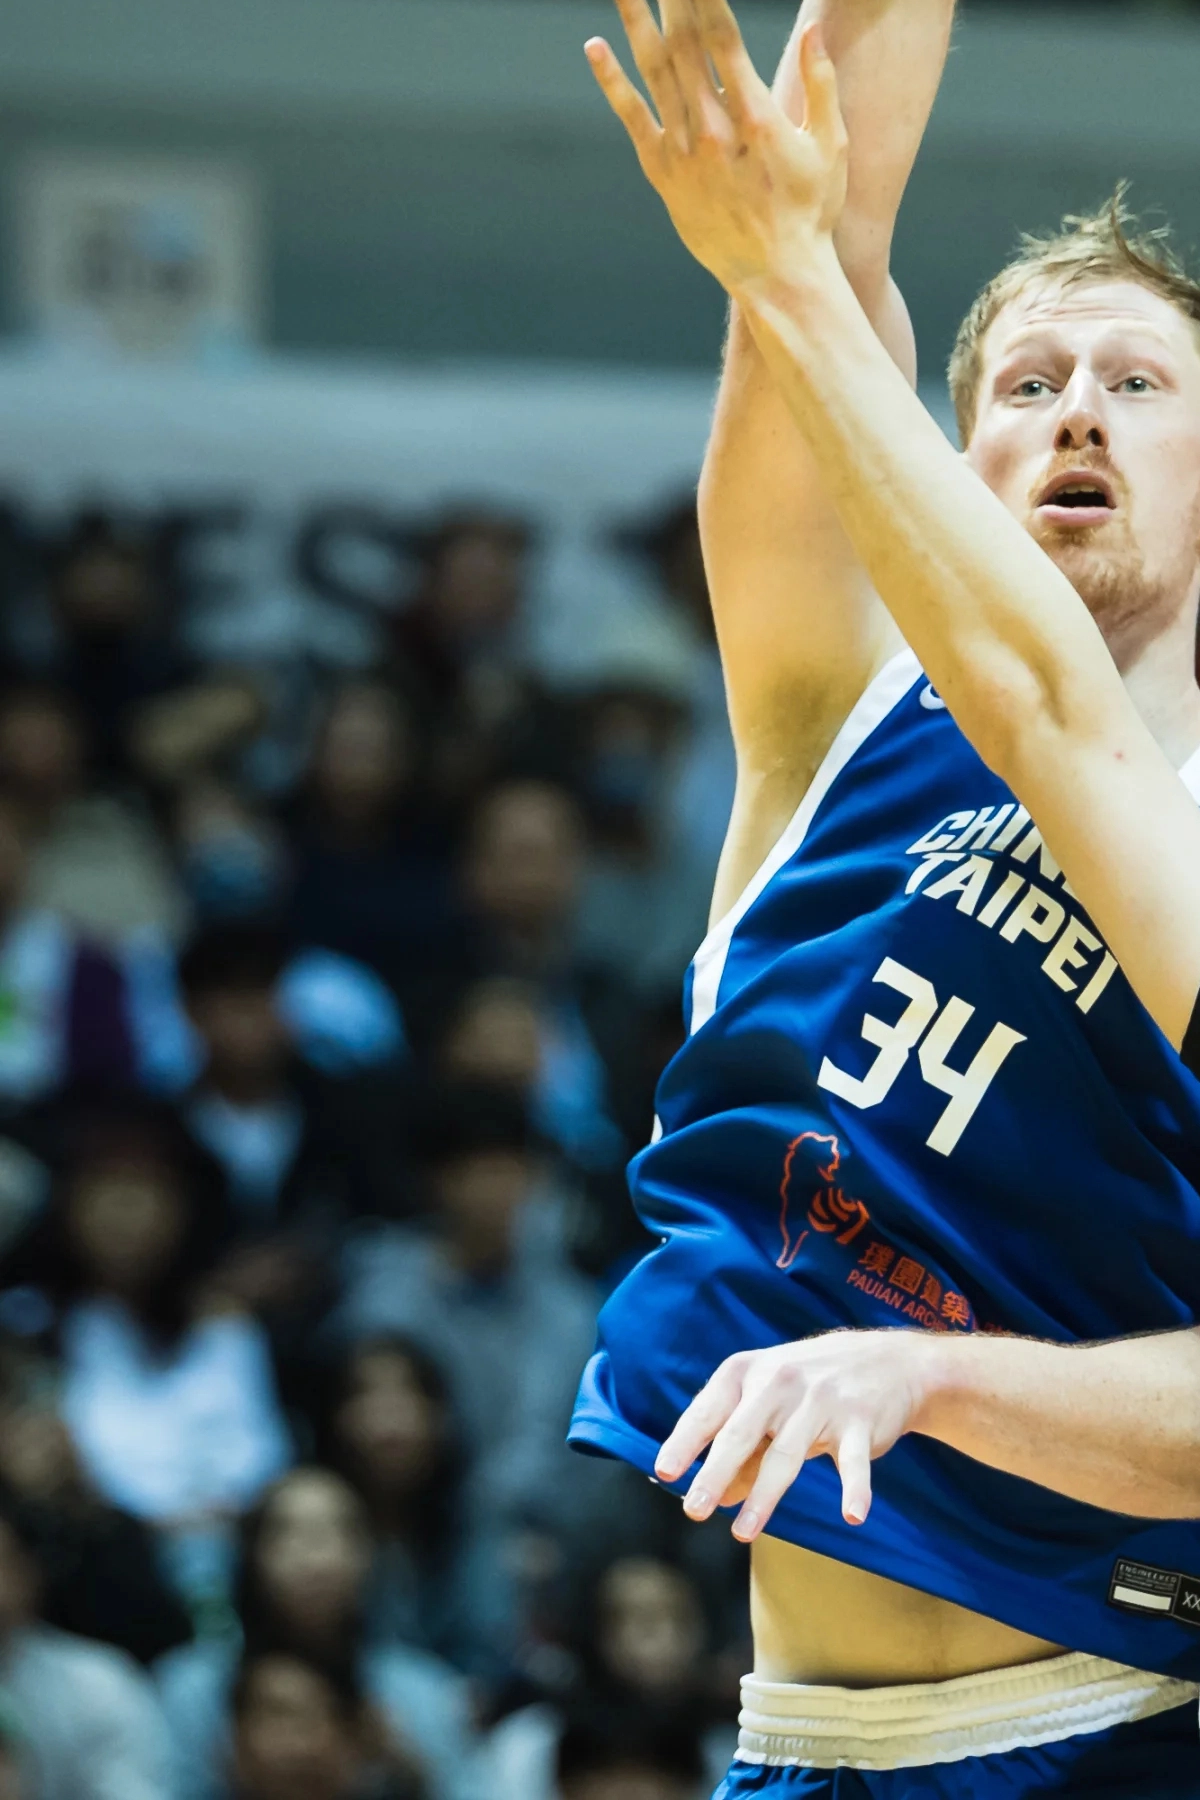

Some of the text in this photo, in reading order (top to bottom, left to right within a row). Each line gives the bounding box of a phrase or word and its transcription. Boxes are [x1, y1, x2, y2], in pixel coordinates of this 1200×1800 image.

[905, 852, 1119, 1015] TAIPEI
[816, 956, 1029, 1158] 34
[846, 1268, 905, 1309] PAUIAN
